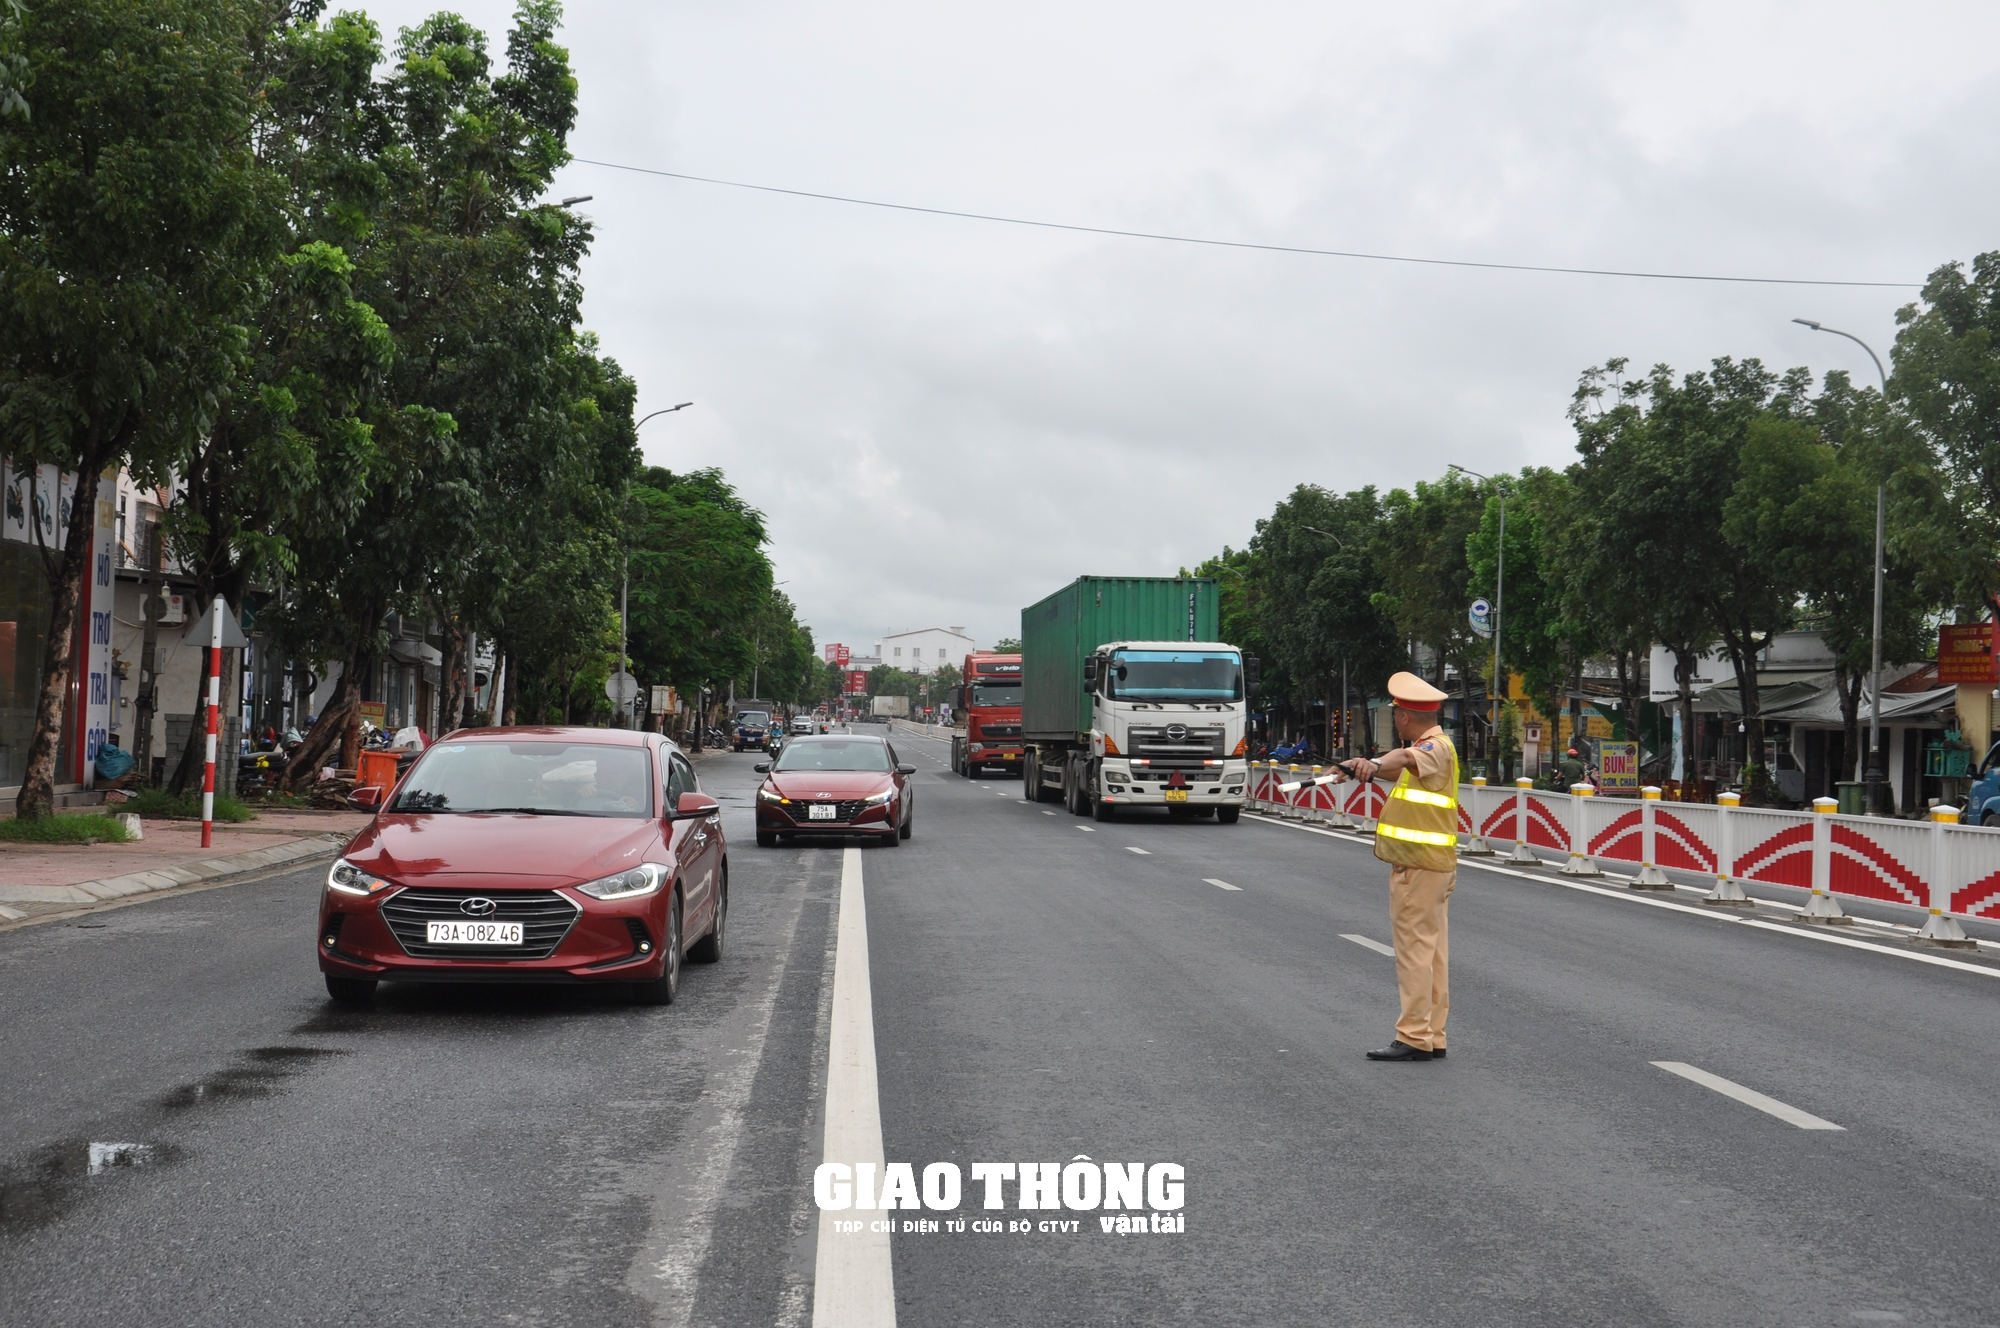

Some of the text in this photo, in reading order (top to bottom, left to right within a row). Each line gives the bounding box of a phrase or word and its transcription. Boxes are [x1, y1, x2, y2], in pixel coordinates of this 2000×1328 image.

[97, 543, 109, 587] HỖ
[92, 610, 111, 652] TRỢ
[90, 661, 108, 705] TRẢ
[1604, 752, 1625, 774] BÚN
[430, 924, 519, 941] 73A-082.46
